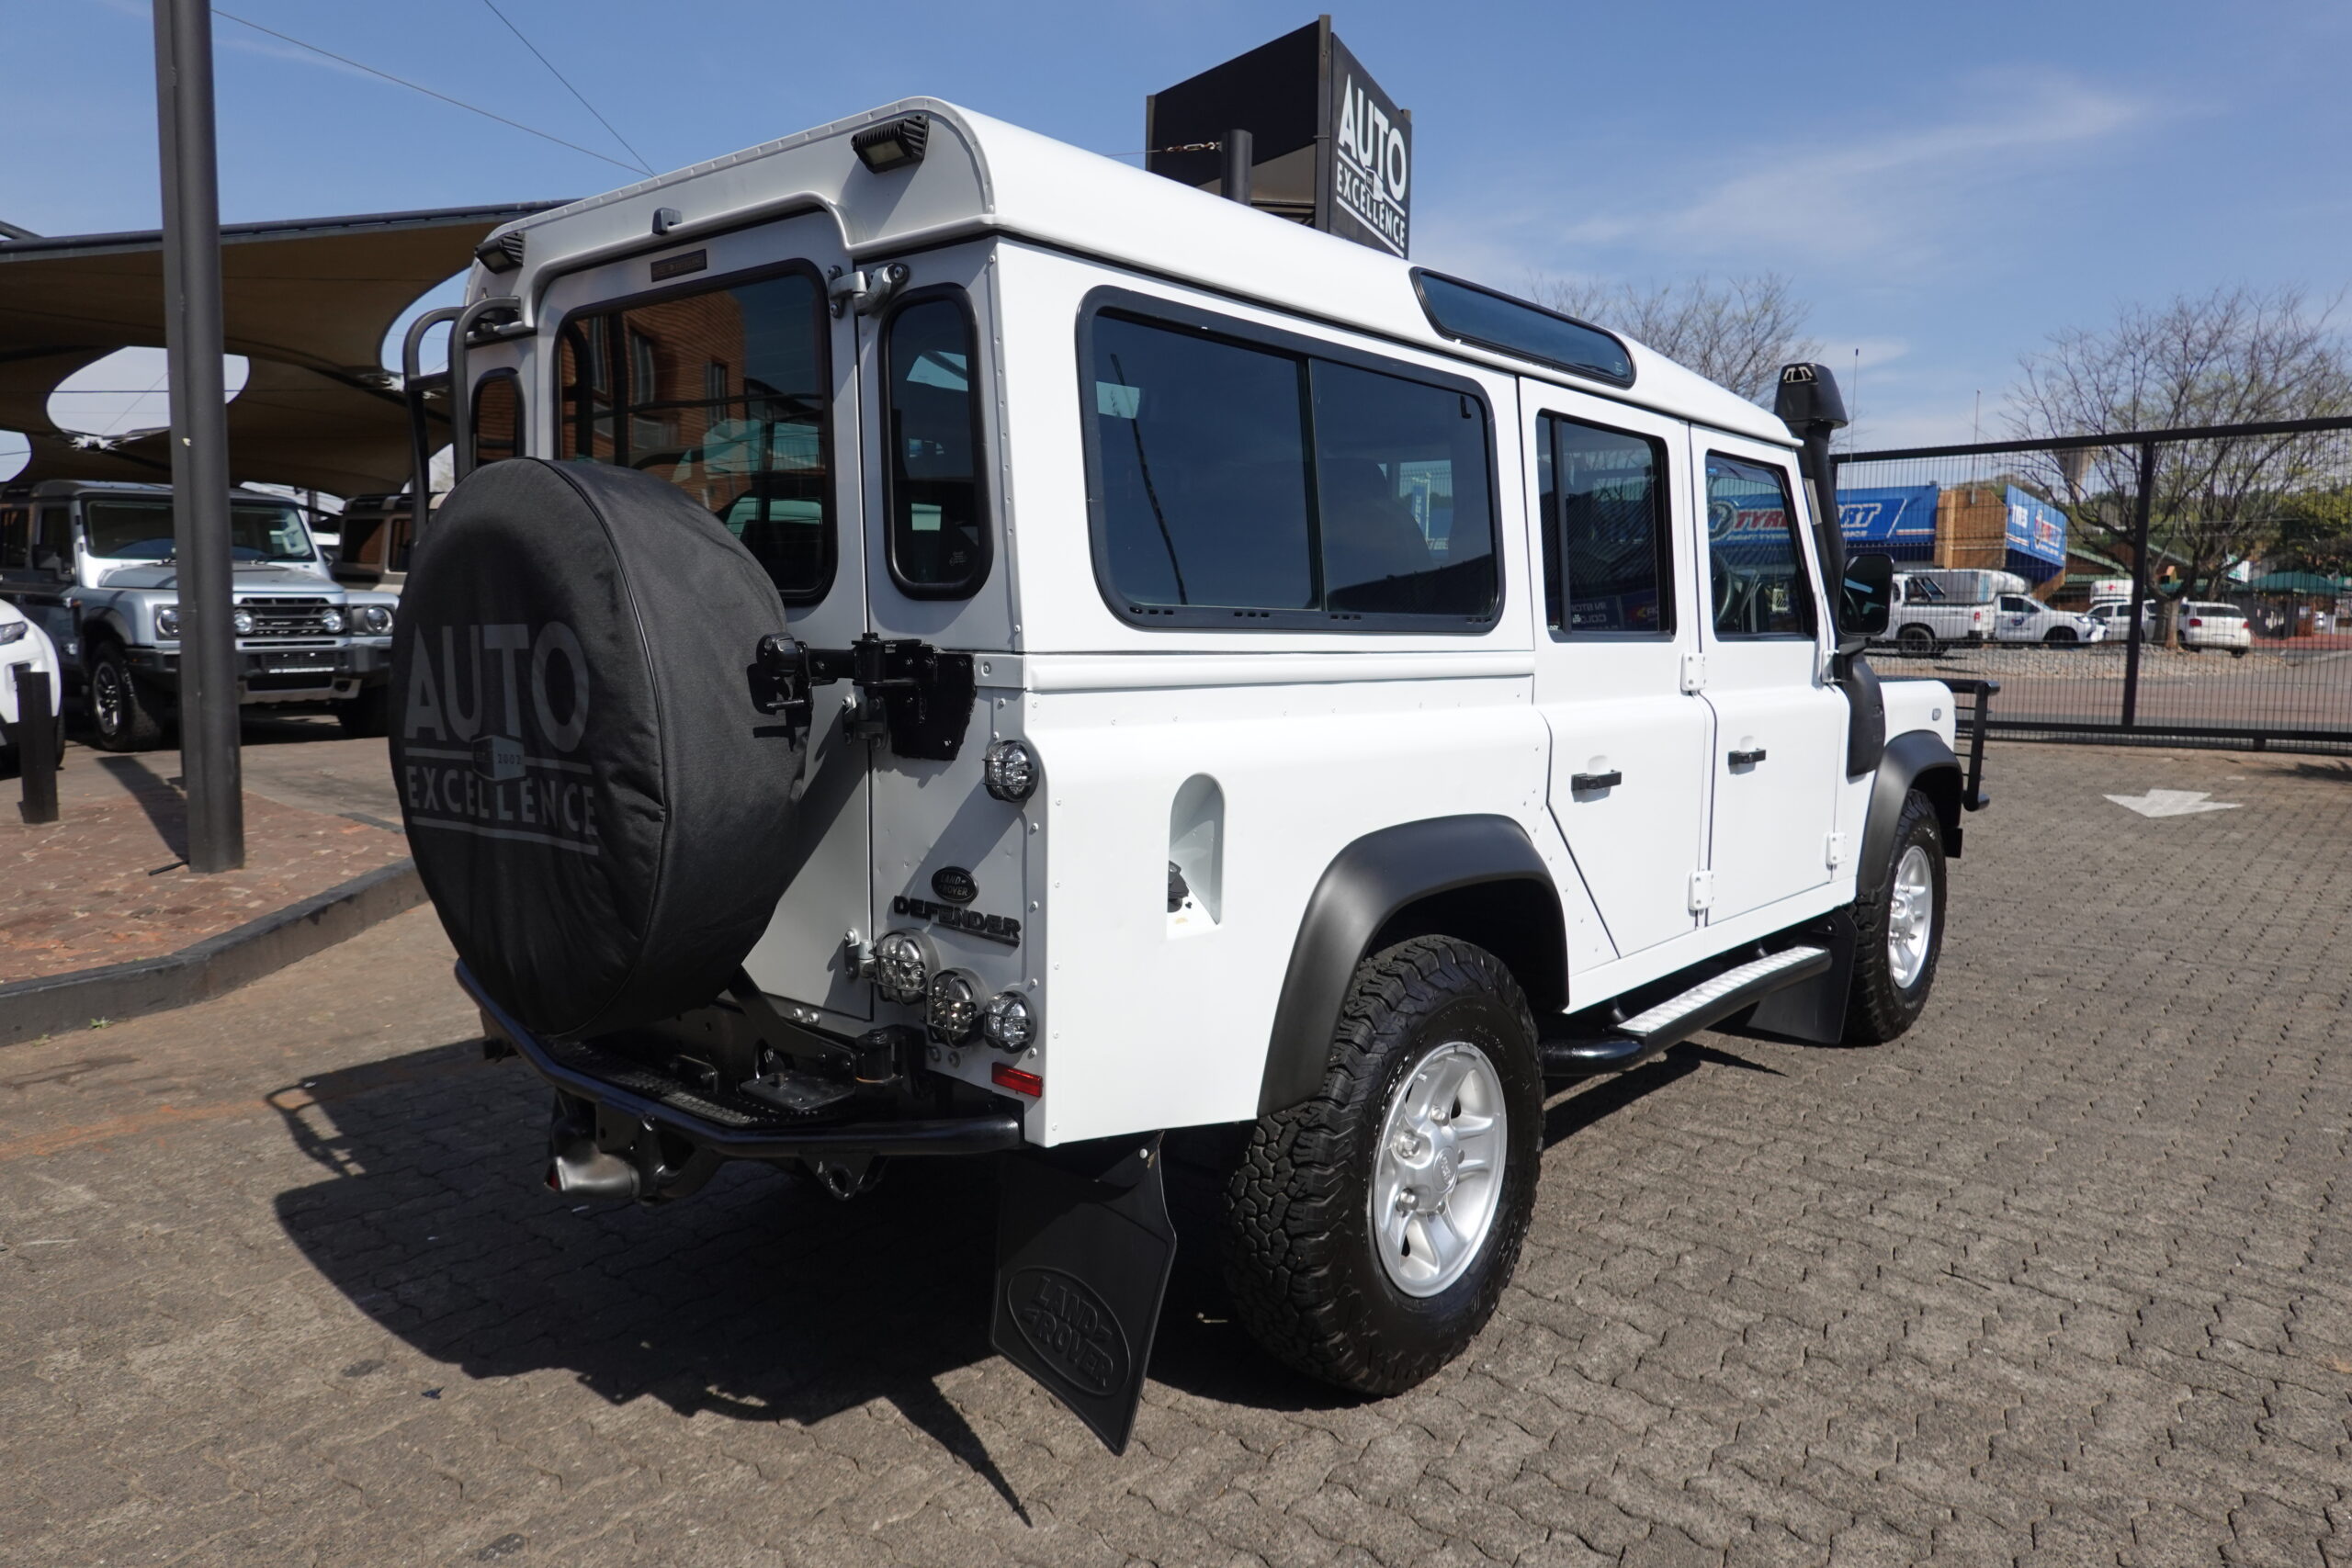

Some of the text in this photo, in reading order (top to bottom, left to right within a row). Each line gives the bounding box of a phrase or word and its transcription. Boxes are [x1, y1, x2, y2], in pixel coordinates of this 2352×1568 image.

[1338, 73, 1407, 201] AUTO
[1337, 161, 1405, 248] EXCELLENCE
[404, 622, 589, 752] AUTO
[405, 765, 598, 836] EXCELLENCE
[940, 874, 961, 885] LAND
[942, 884, 967, 897] ROVER
[894, 896, 1022, 941] DEFENDER
[1035, 1275, 1098, 1332] LAND
[1035, 1310, 1114, 1387] ROVER
